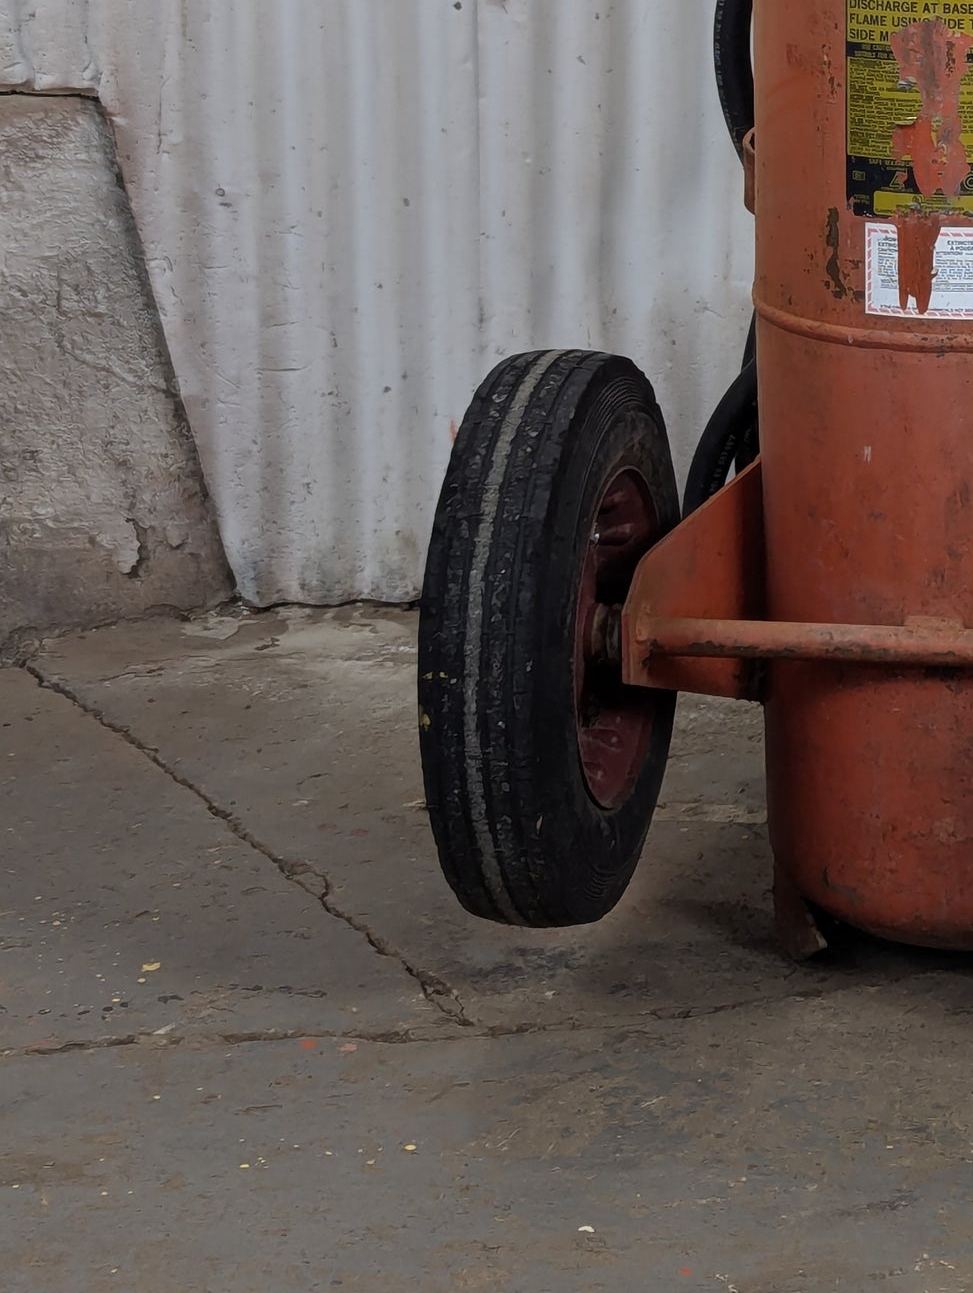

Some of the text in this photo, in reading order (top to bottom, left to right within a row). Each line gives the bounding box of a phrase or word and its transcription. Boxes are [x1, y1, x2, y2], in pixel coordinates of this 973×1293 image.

[922, 3, 939, 14] AT
[850, 13, 887, 27] FLAME
[849, 28, 875, 41] SIDE
